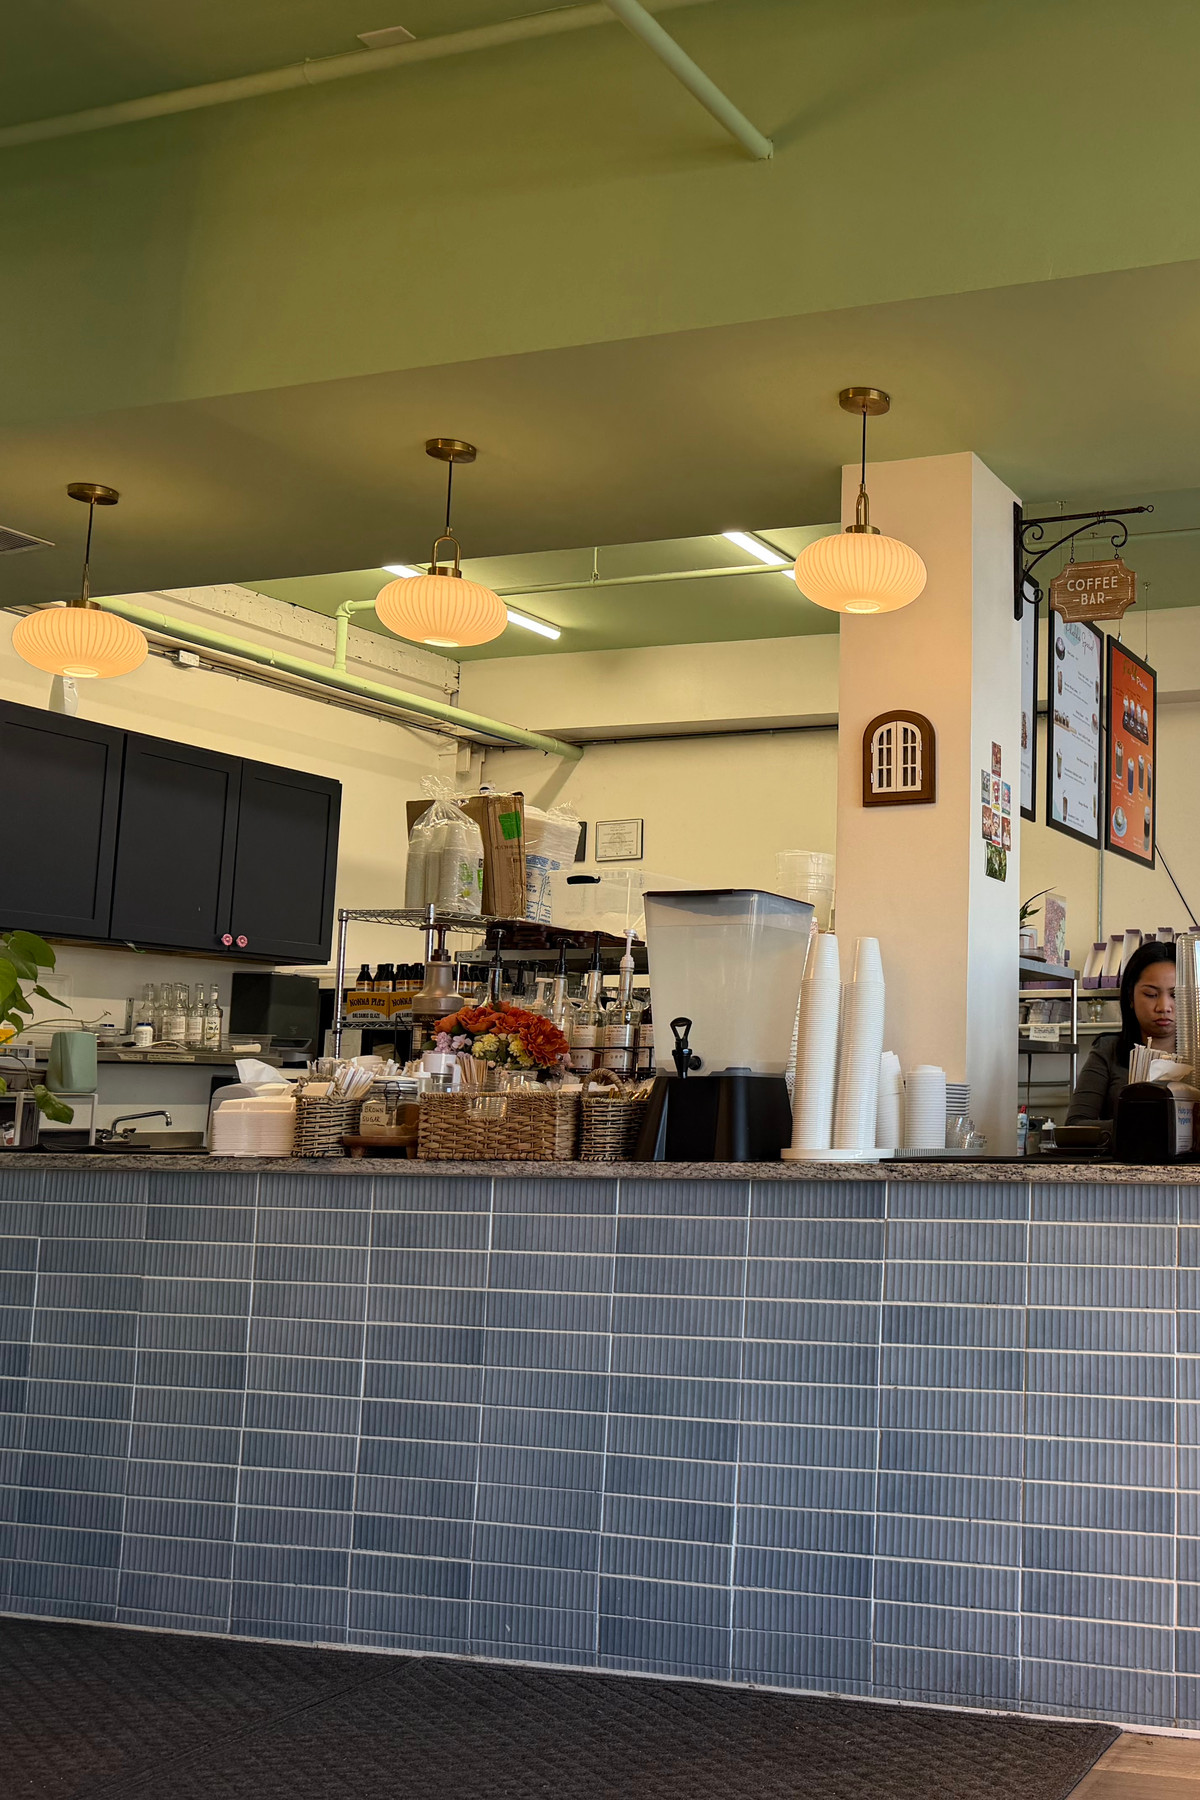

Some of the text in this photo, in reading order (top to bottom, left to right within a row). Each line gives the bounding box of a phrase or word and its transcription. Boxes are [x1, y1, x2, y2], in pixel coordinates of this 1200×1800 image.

[1067, 576, 1118, 592] COFFEE
[349, 997, 370, 1007] NONNA
[364, 1105, 385, 1113] BROWN
[362, 1115, 381, 1123] SUGAR
